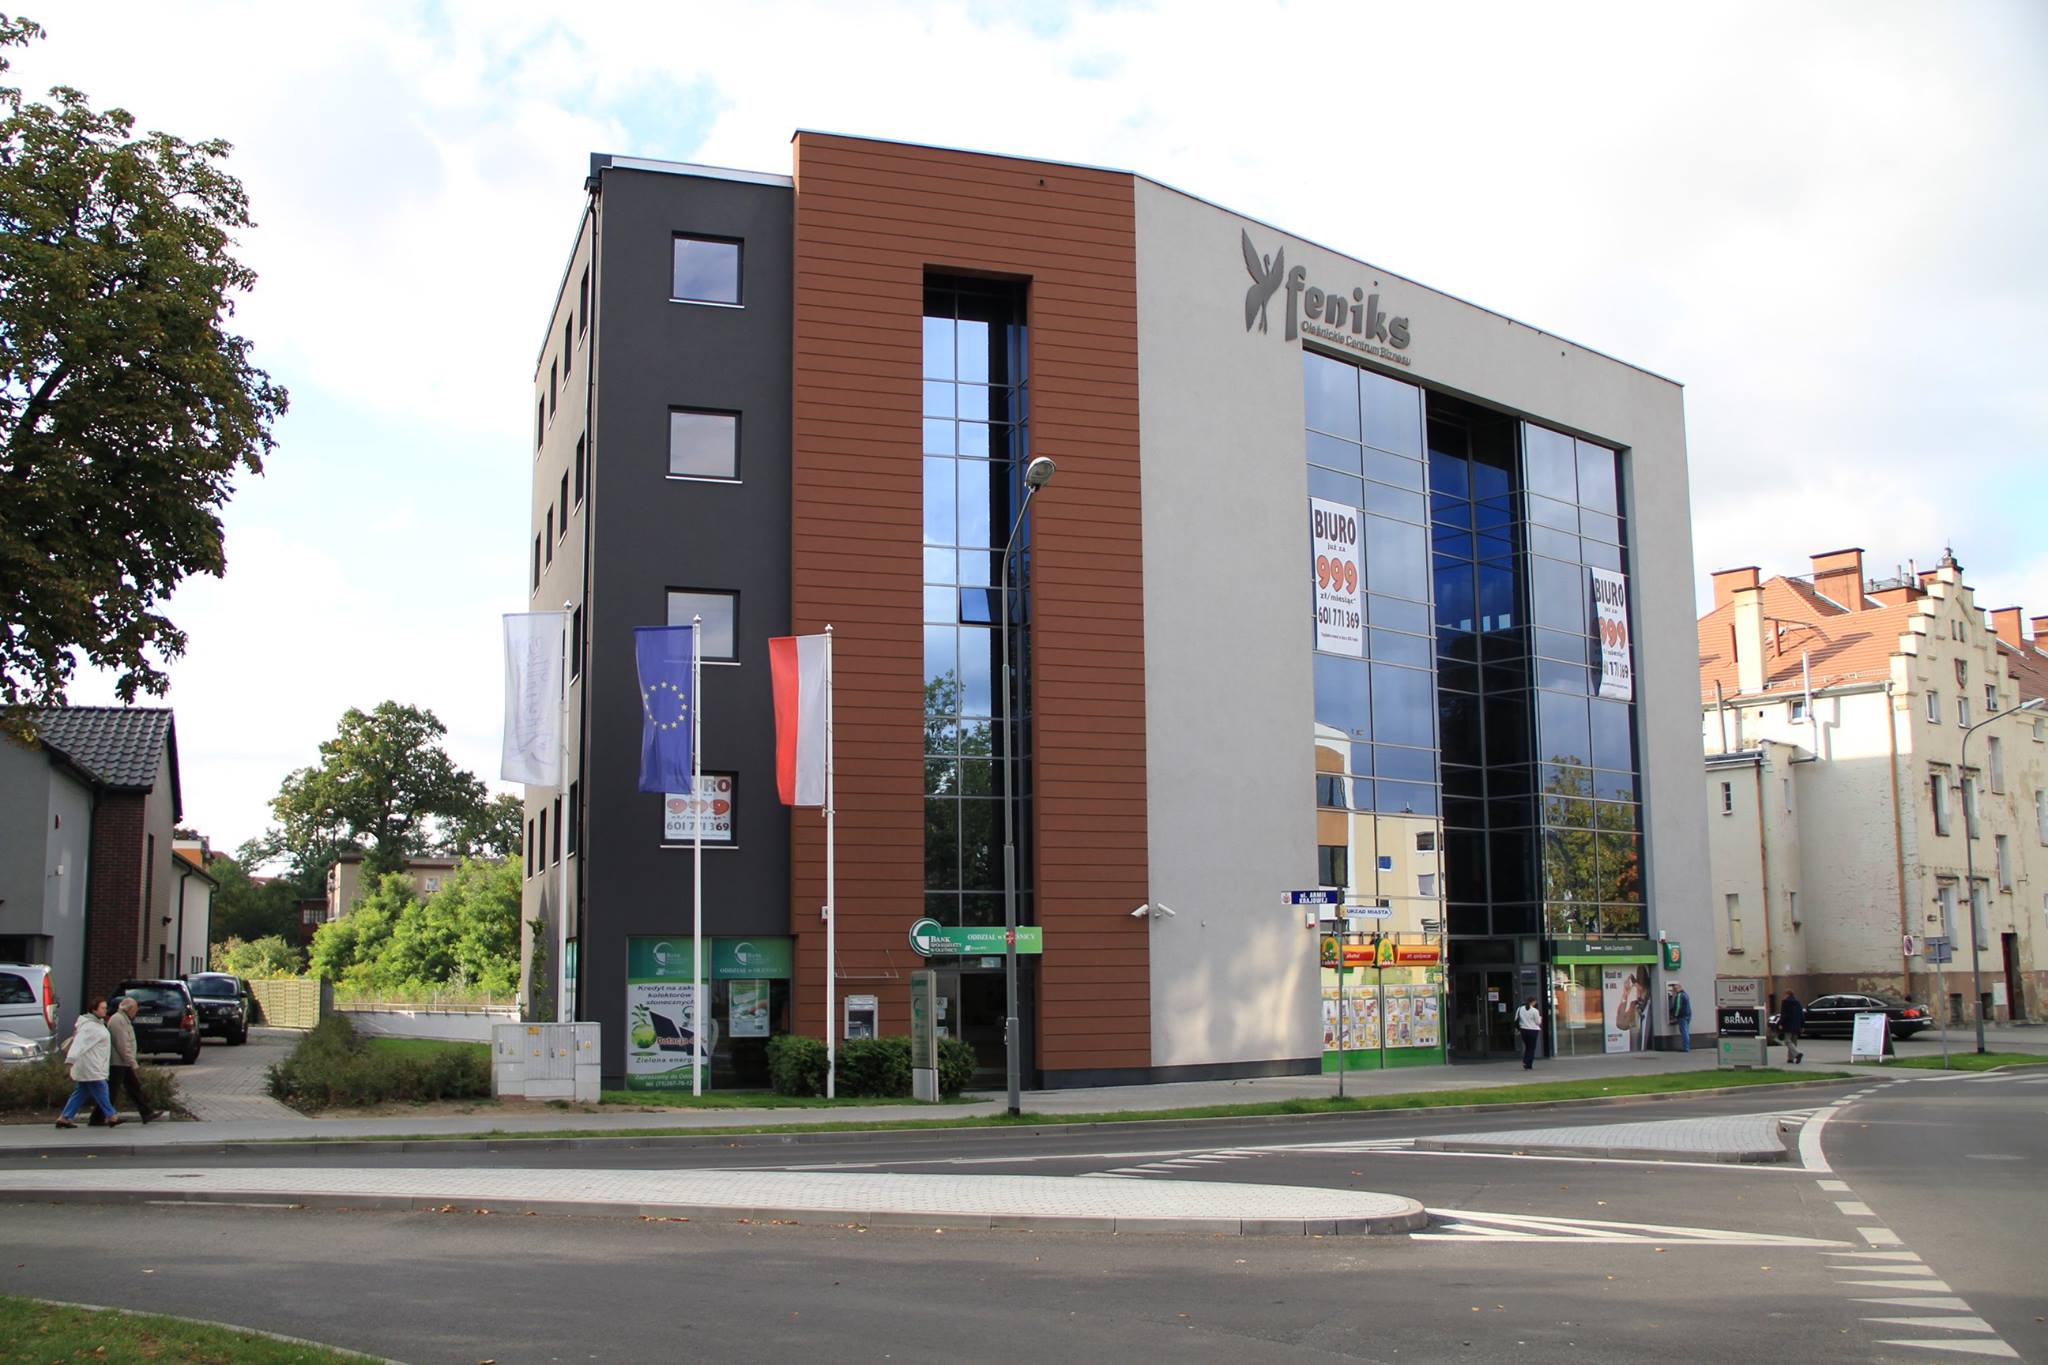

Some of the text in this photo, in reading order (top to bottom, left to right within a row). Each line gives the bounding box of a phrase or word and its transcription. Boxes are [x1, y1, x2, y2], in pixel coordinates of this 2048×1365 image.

[1285, 265, 1410, 350] feniks
[1346, 335, 1380, 355] Centrum
[1380, 346, 1412, 366] Biznesu
[1314, 509, 1356, 546] BIURO
[1316, 554, 1358, 595] 999
[1594, 578, 1624, 608] BIURO
[1318, 606, 1360, 629] 601 771 369
[666, 822, 686, 830] 601
[710, 822, 730, 831] 369
[1728, 984, 1750, 992] LINK4
[1724, 1011, 1754, 1024] BRAMA
